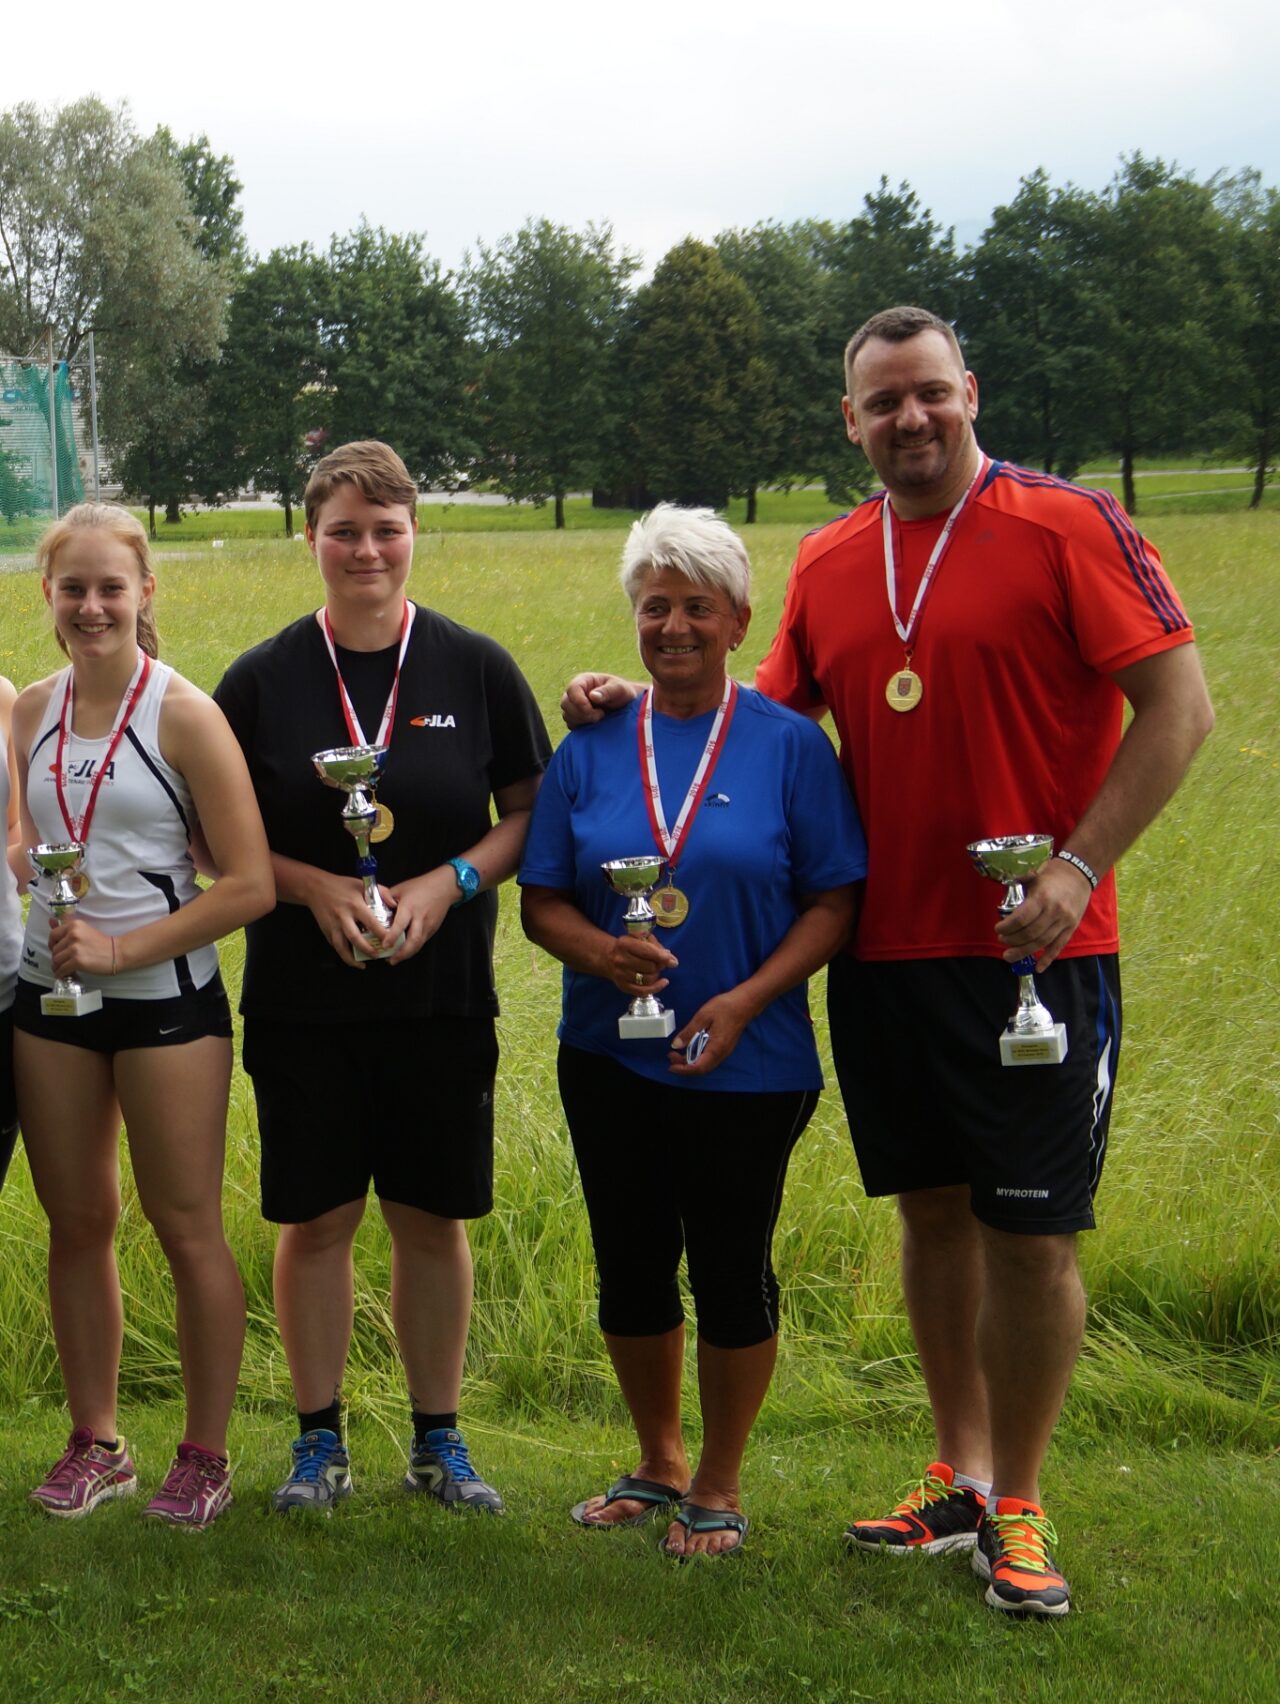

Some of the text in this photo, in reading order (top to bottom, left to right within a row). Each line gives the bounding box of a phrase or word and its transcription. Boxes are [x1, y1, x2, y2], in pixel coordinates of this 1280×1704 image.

[429, 715, 456, 728] JLA
[1059, 851, 1071, 860] GO
[1071, 856, 1093, 878] HARD
[996, 1187, 1049, 1199] MYPROTEIN
